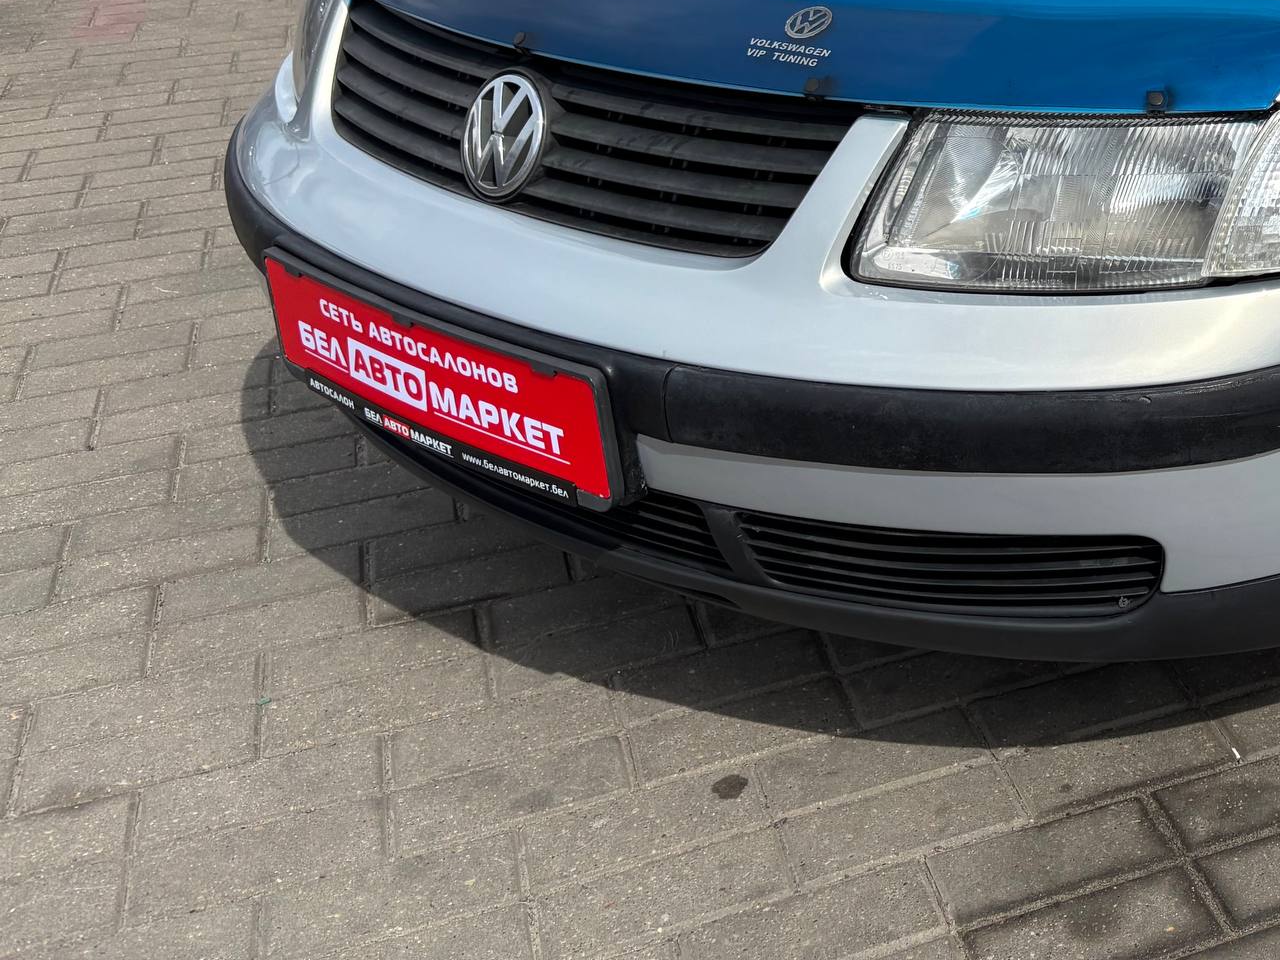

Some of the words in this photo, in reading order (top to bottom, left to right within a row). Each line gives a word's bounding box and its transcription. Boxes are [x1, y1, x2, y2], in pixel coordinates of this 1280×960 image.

[747, 48, 767, 58] VIP
[772, 52, 818, 67] TUNING
[750, 37, 831, 58] VOLKSWAGEN
[319, 298, 363, 333] СЕТЬ
[369, 321, 518, 394] АВТОСАЛОНОВ
[309, 378, 355, 410] АВТОСАЛОН
[461, 452, 569, 498] www.белавтомаркет.бел
